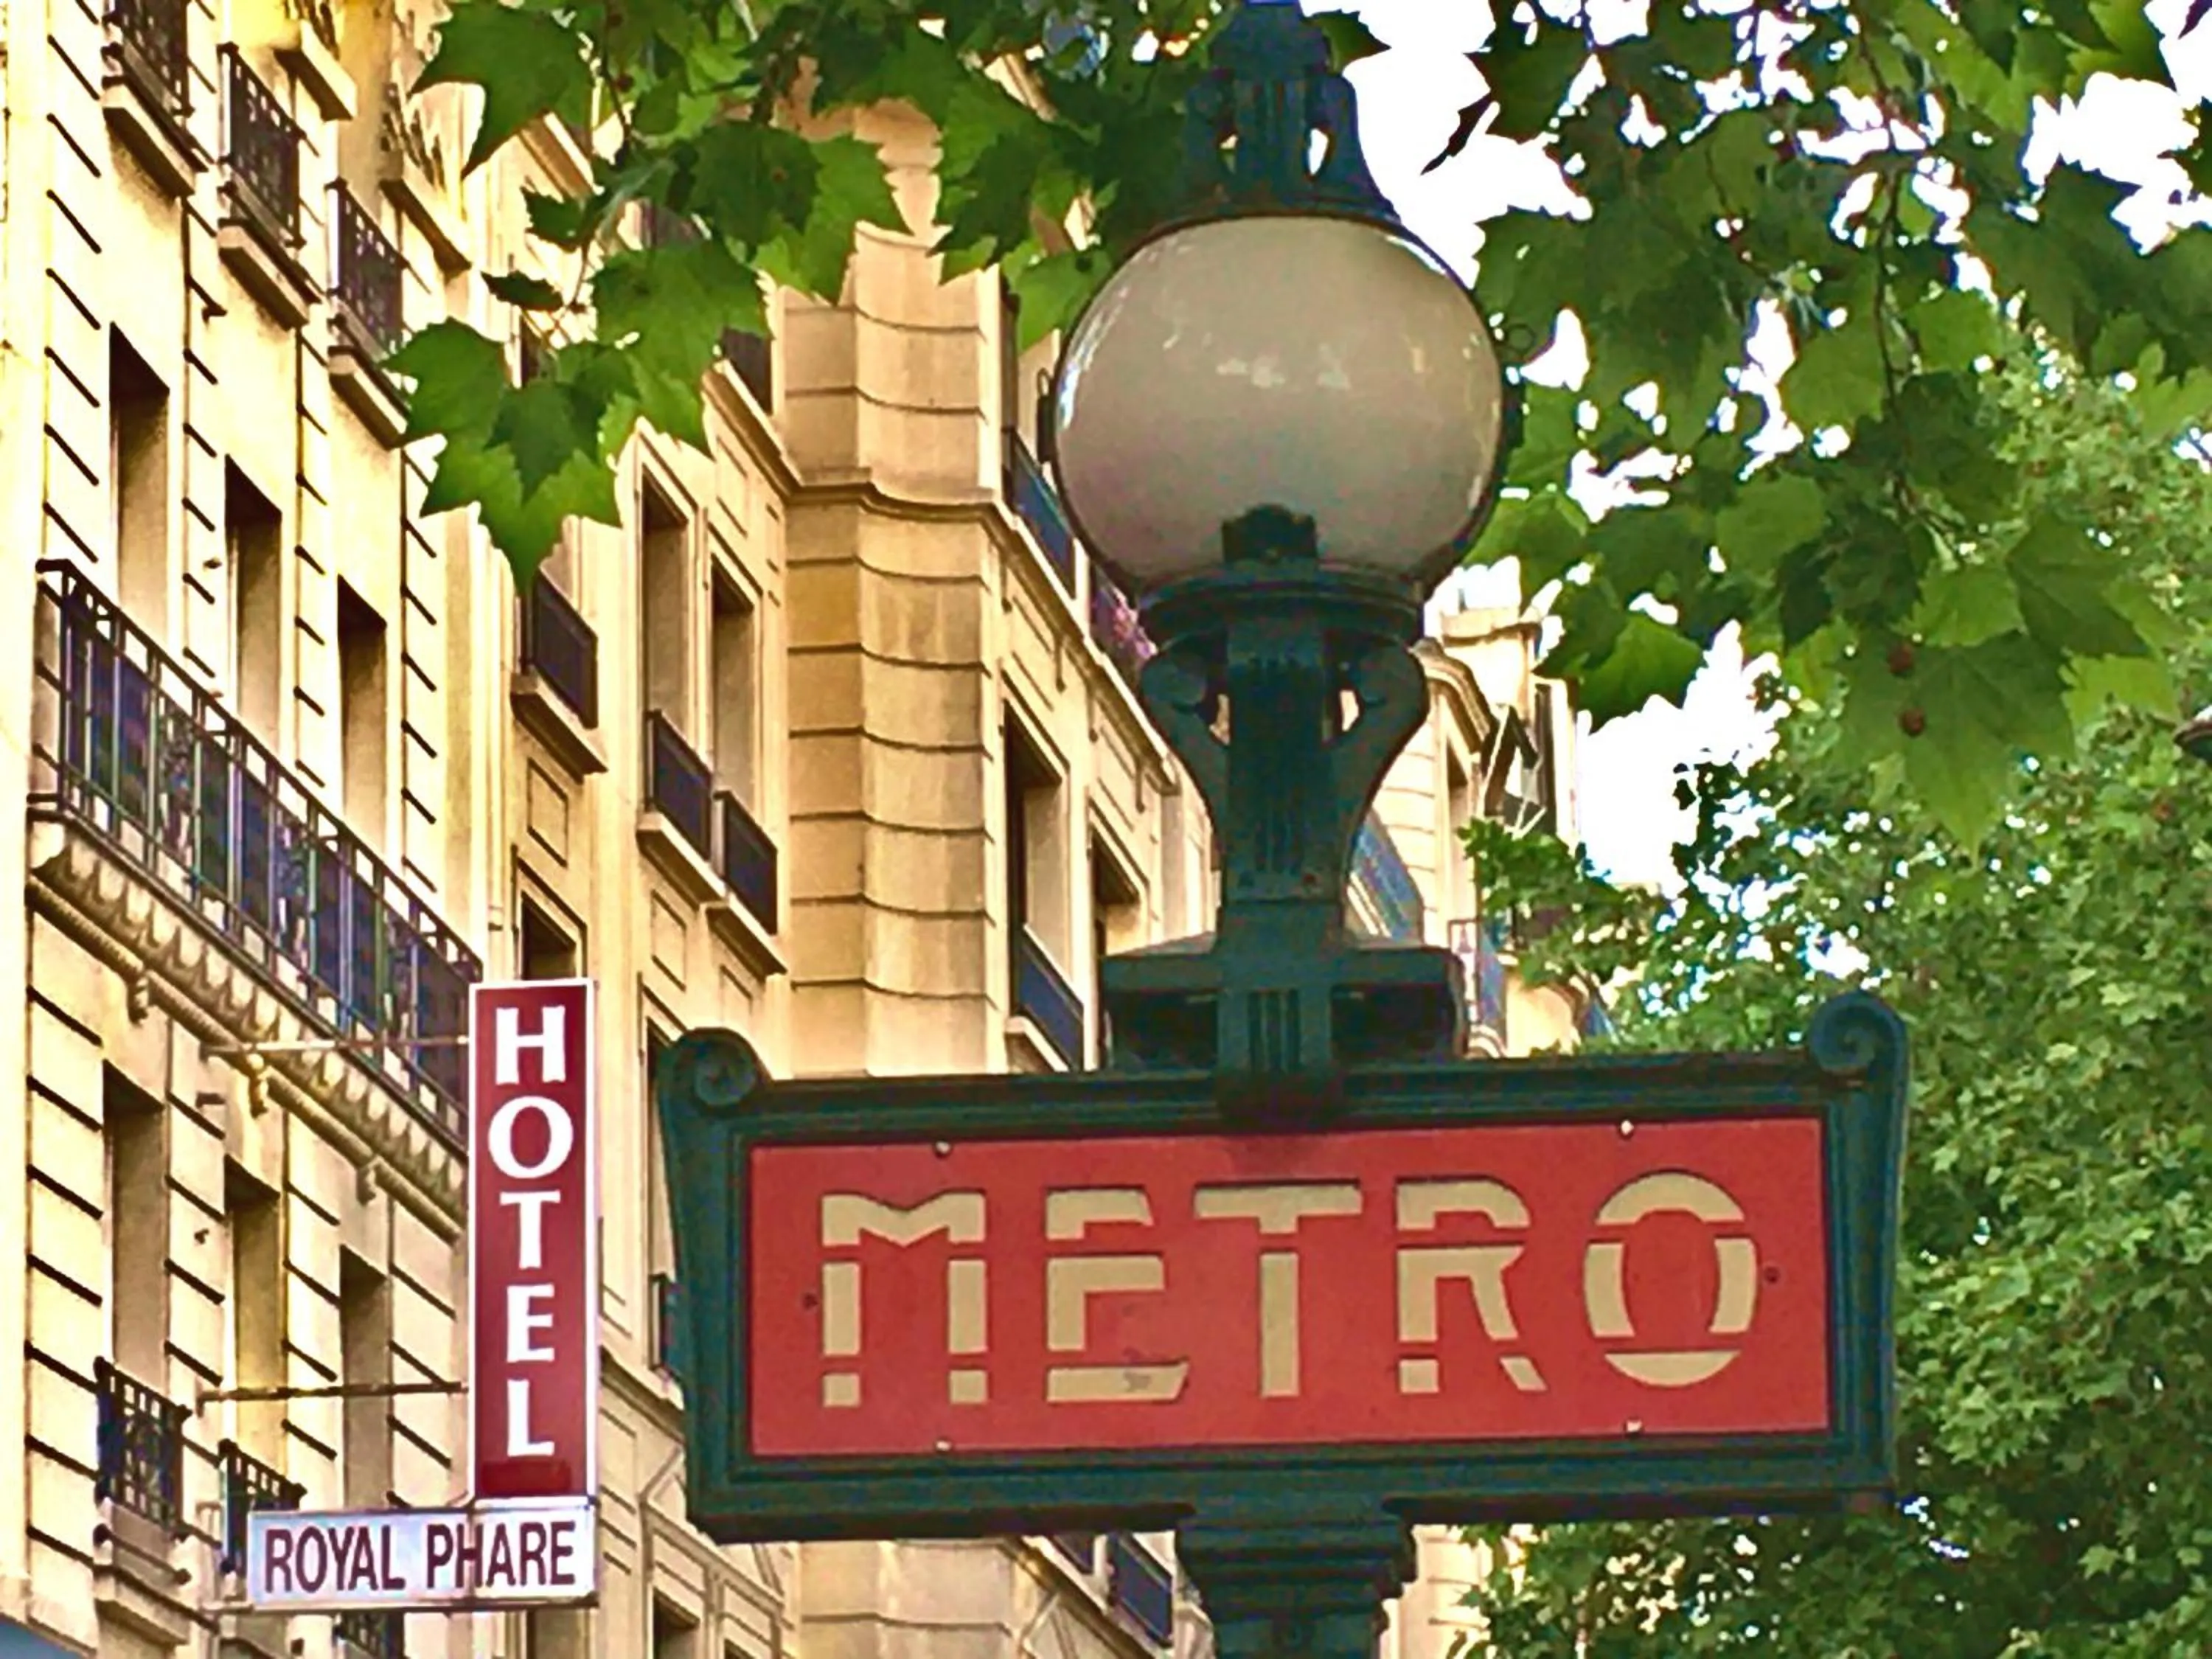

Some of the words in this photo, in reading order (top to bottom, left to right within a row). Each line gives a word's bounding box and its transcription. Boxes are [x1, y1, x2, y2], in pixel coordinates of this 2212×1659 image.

[488, 1006, 574, 1457] HOTEL
[821, 1171, 1759, 1408] METRO
[266, 1526, 405, 1593] ROYAL
[428, 1522, 576, 1587] PHARE
